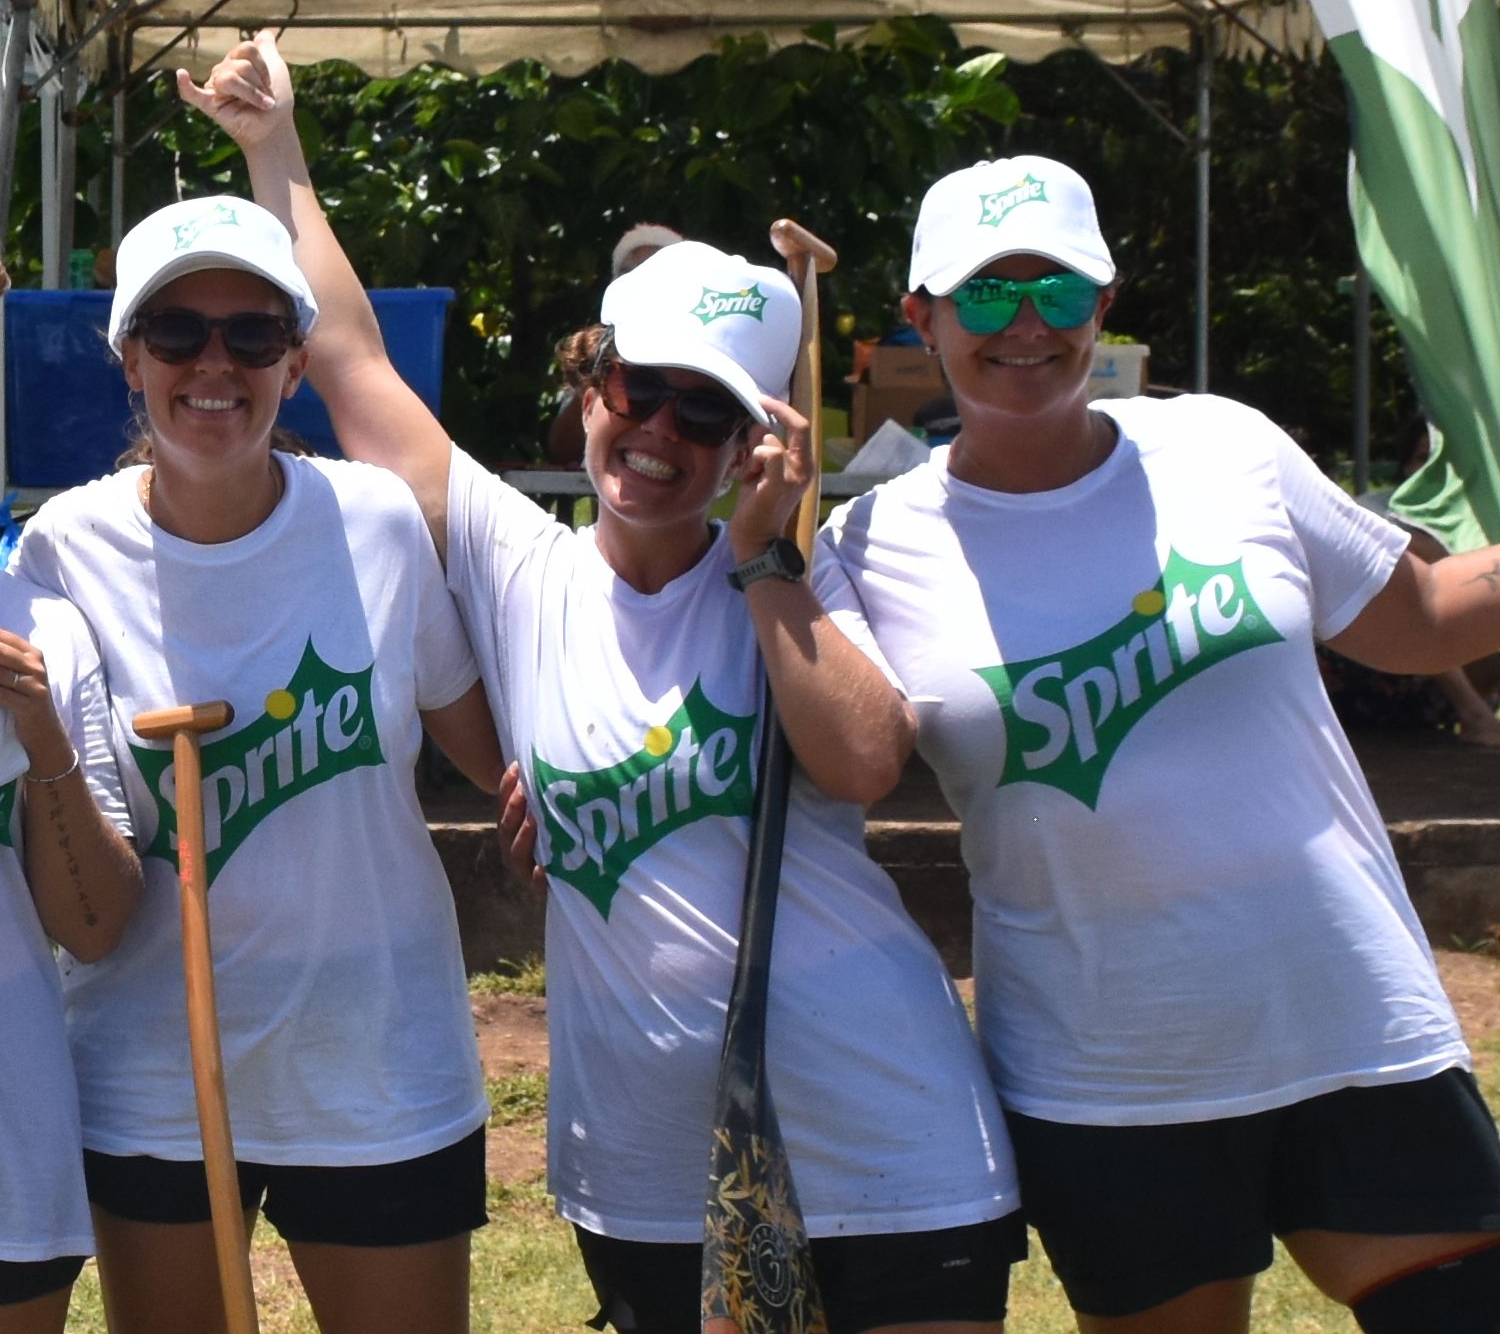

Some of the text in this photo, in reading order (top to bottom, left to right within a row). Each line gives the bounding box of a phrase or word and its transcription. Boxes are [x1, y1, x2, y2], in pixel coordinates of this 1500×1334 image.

[981, 179, 1042, 223] Sprite
[695, 289, 763, 318] Sprite
[1012, 573, 1244, 770] Sprite
[543, 725, 740, 876] Sprite
